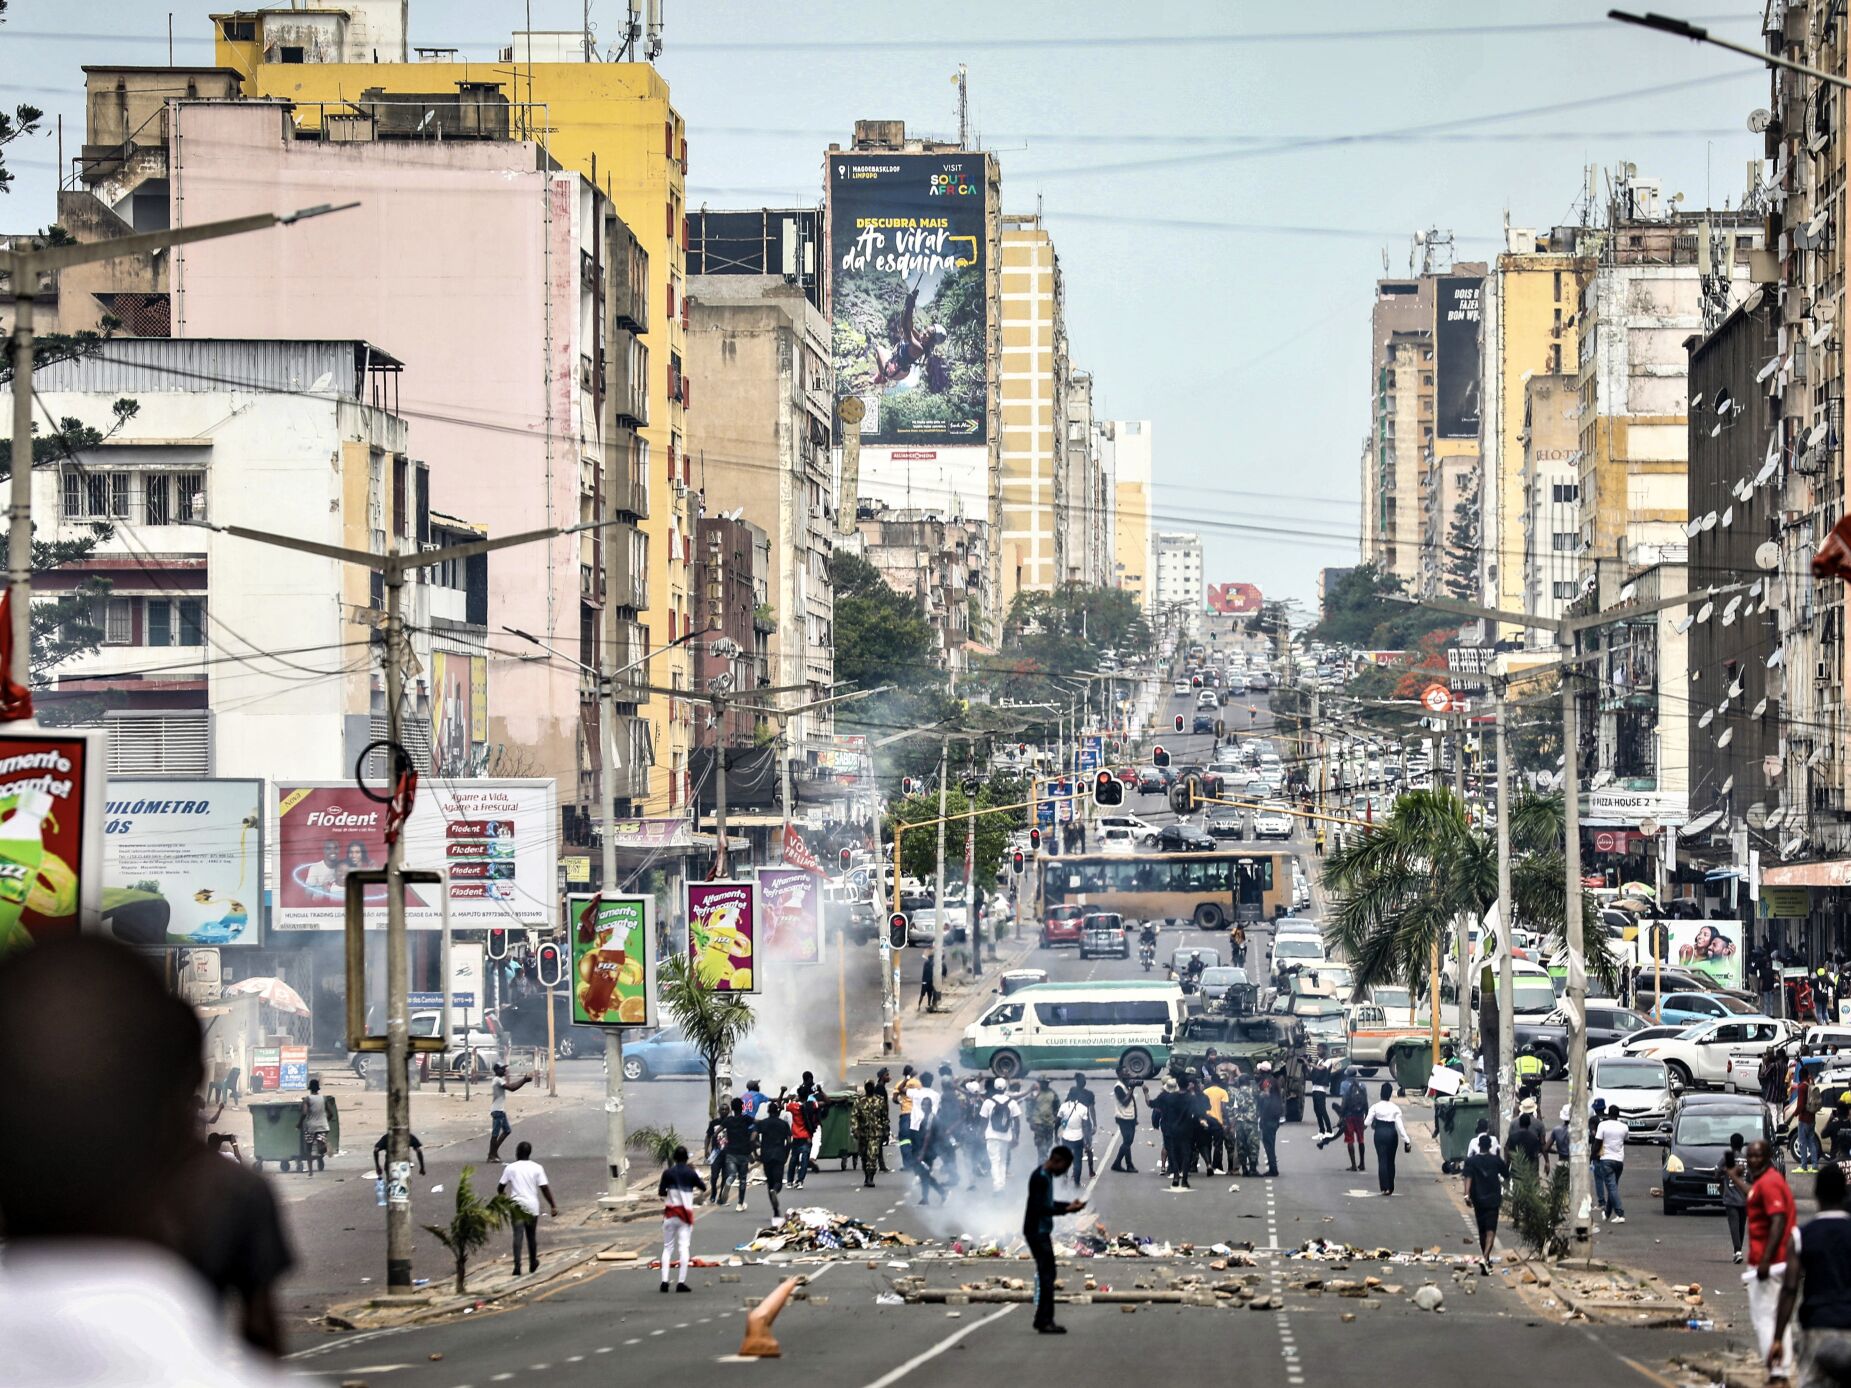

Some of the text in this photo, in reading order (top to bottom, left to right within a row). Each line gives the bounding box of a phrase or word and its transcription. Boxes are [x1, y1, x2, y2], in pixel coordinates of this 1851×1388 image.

[943, 164, 962, 172] VISIT
[929, 185, 977, 196] AFRCA
[856, 218, 948, 228] DESCUBRA MAIS
[856, 224, 950, 263] Ao virar
[842, 246, 955, 280] da esquina
[1454, 289, 1473, 299] DOIS
[1447, 310, 1465, 321] BOM
[1537, 449, 1576, 461] HOT
[284, 792, 301, 808] Nova
[451, 793, 479, 802] Agarre
[489, 793, 509, 802] Vida,
[1597, 798, 1613, 807] PIZZA
[1614, 798, 1641, 807] HOUSE
[1644, 798, 1650, 806] 2
[104, 798, 211, 815] UILÓMETRO,
[443, 803, 471, 813] Agarre
[306, 812, 378, 827] Flodent
[104, 818, 133, 834] ÓS
[451, 825, 481, 833] Flodent
[451, 846, 484, 854] Flodent
[785, 846, 816, 868] FRELIMO
[451, 866, 480, 874] Flodent
[771, 873, 811, 888] Altamente
[450, 887, 483, 896] Flodent
[763, 882, 812, 898] Refrescante!
[702, 889, 747, 906] Altamente
[692, 899, 747, 917] Refrescante!
[598, 962, 617, 971] FIZZ
